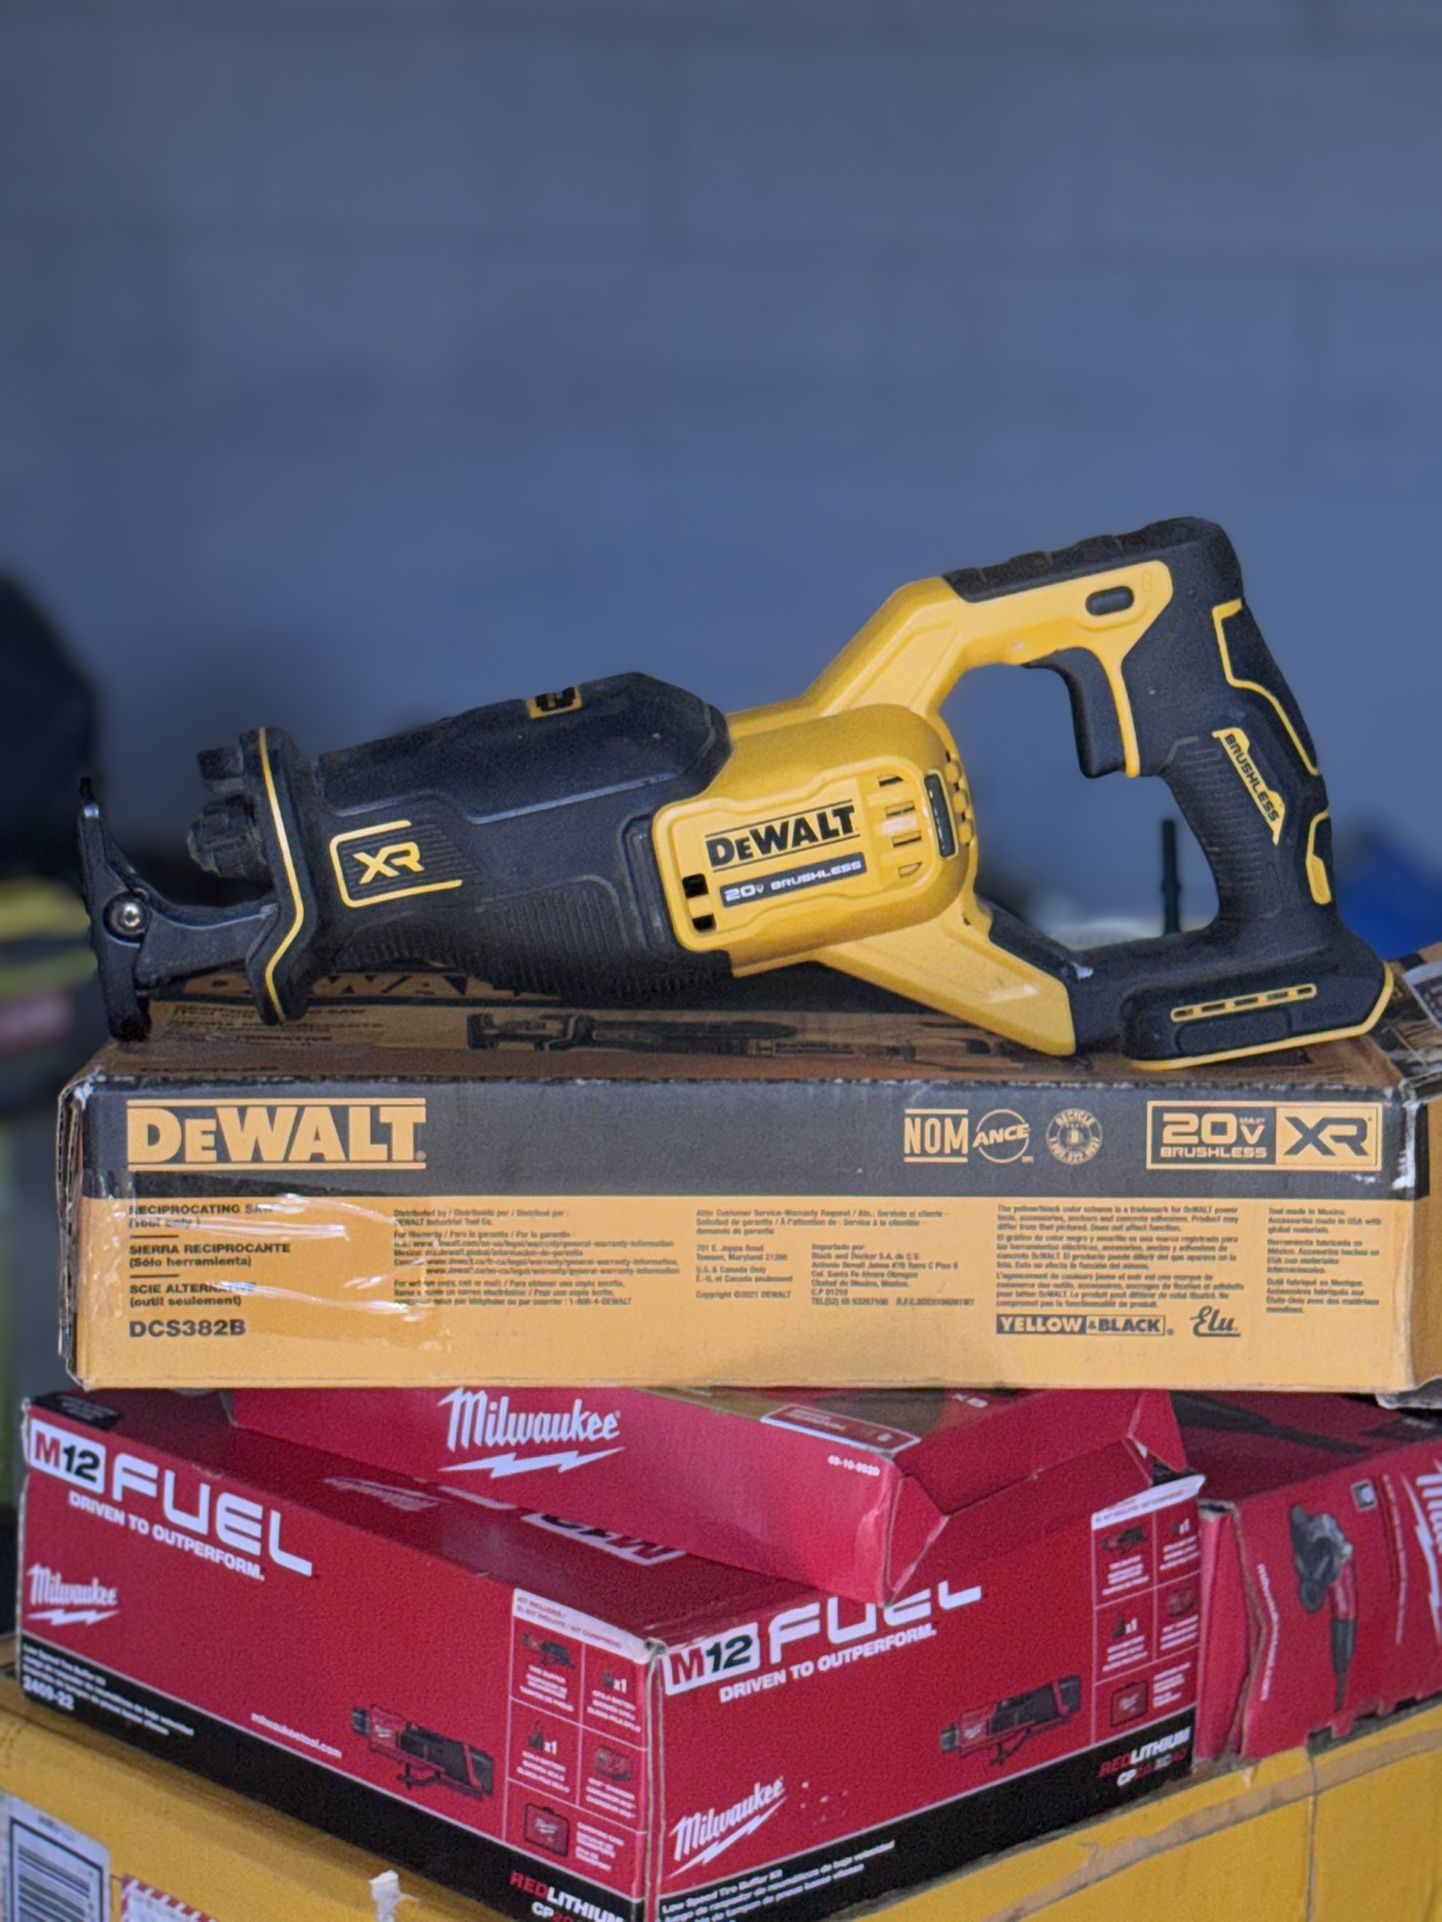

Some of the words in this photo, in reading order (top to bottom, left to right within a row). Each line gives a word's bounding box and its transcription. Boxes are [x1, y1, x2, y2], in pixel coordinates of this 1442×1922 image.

[1224, 733, 1280, 822] BRUSHLESS
[352, 840, 426, 884] XR
[769, 858, 864, 891] BRUSHLESS
[903, 1116, 968, 1154] NOM
[972, 1122, 1032, 1148] ANCE
[1160, 1146, 1268, 1158] BRUSHLESS
[1282, 1115, 1370, 1156] XR
[129, 1244, 179, 1255] SIERRA
[183, 1243, 290, 1254] RECIPROCANTE
[166, 1256, 252, 1268] herramienta)
[129, 1284, 163, 1294] SCIE
[129, 1297, 164, 1309] (outil
[167, 1296, 242, 1308] seulement)
[128, 1318, 246, 1338] DCS382B
[999, 1316, 1087, 1333] YELLOW
[1098, 1317, 1161, 1333] BLACK
[438, 1387, 621, 1452] Milwaukee
[34, 1431, 101, 1483] M12
[112, 1452, 314, 1577] FUEL
[68, 1490, 126, 1526] DRIVEN
[129, 1513, 150, 1536] TO
[152, 1523, 265, 1582] OUTPERFORM.
[26, 1562, 118, 1607] Milwaukee
[671, 1633, 755, 1685] M12
[768, 1580, 983, 1665] FUEL
[719, 1668, 787, 1704] DRIVEN
[790, 1660, 815, 1679] TO
[816, 1622, 938, 1673] OUTPERFORM.
[1100, 1726, 1192, 1778] REDLITHIUM
[668, 1776, 786, 1862] Milwaukee
